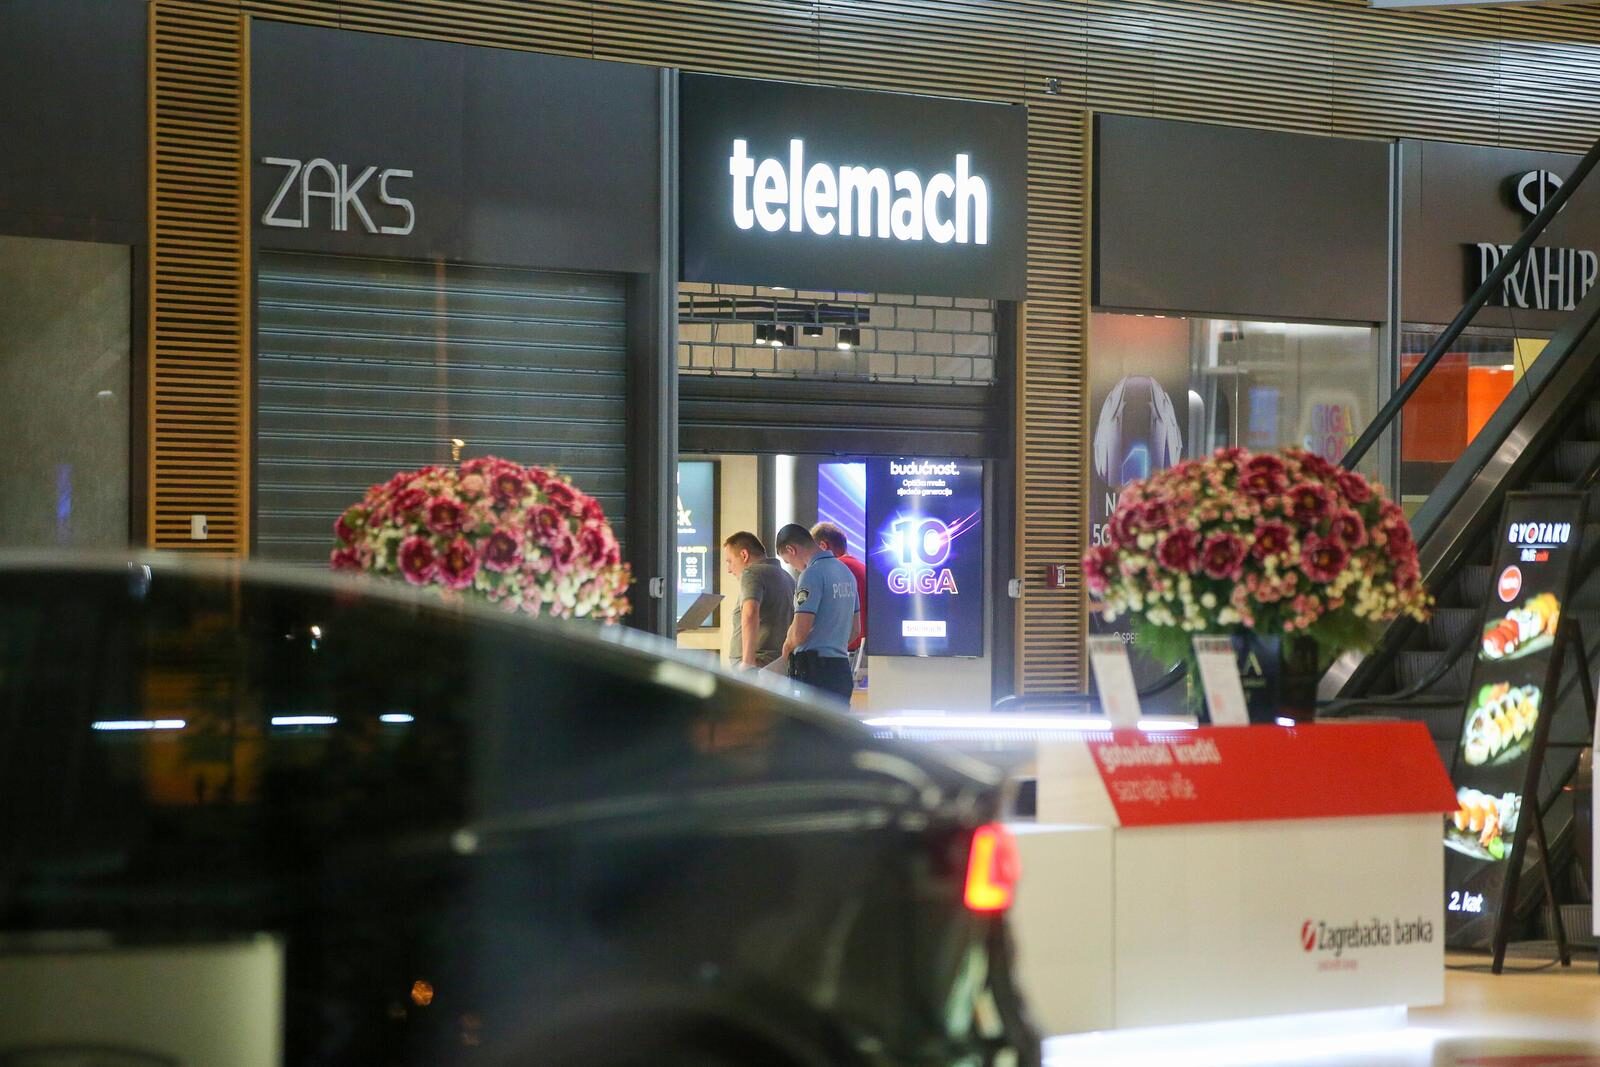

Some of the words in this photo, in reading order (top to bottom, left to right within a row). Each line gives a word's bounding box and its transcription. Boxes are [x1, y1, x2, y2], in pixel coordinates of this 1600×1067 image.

[261, 157, 415, 235] ZAKS
[729, 139, 988, 244] telemach
[890, 461, 960, 475] budućnost.
[892, 518, 950, 566] 10
[1508, 522, 1571, 544] GYOTAKU
[888, 567, 958, 594] GIGA
[1461, 891, 1483, 912] kat
[1318, 918, 1391, 957] Zagrebačka
[1394, 916, 1433, 945] banka
